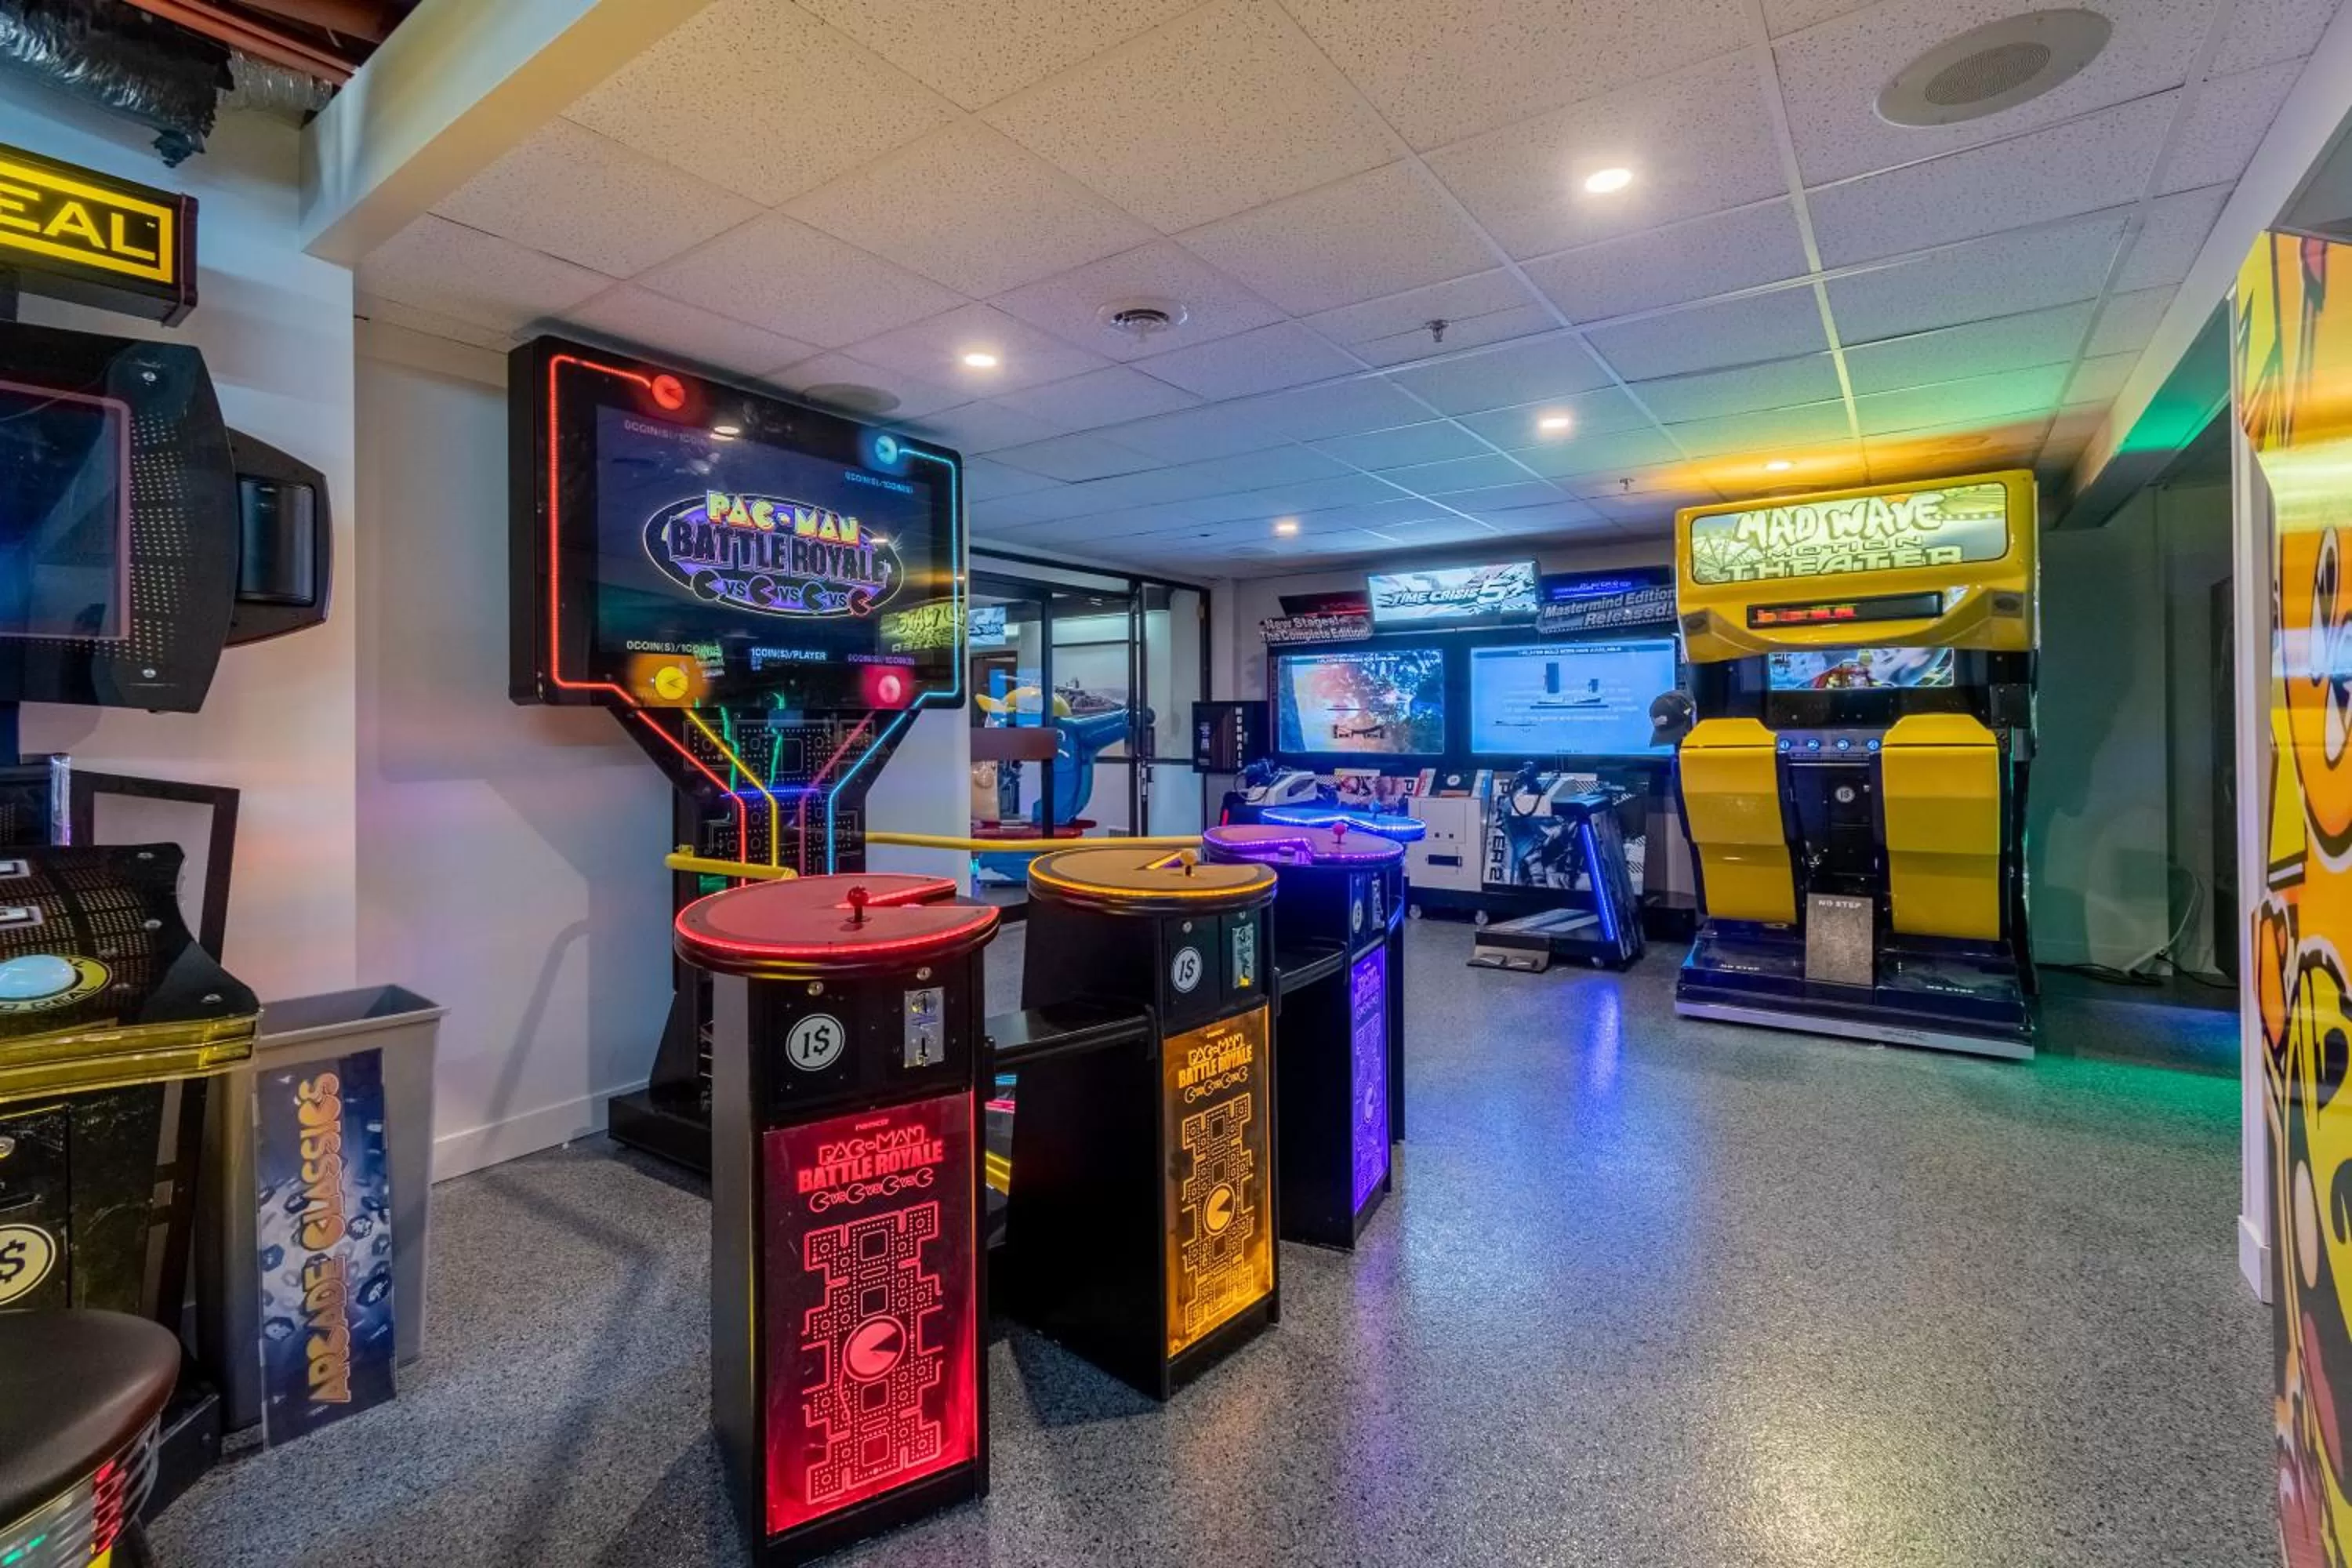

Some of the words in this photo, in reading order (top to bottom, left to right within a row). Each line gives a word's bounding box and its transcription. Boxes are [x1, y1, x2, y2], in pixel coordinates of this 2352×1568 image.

[706, 489, 861, 546] PAC-MAN
[1734, 505, 1819, 548] MAD
[1826, 492, 1947, 539] WAVE
[669, 515, 789, 577] BATTLE
[789, 533, 893, 588] ROYALE
[1769, 535, 1923, 558] MOTION
[1726, 546, 1963, 582] THEATER
[725, 579, 746, 597] VS
[777, 586, 800, 603] VS
[829, 593, 848, 608] VS
[1390, 587, 1428, 606] TIME
[1428, 589, 1479, 603] CRISIS
[1544, 595, 1624, 619] Mastermind
[1624, 587, 1677, 607] Edition
[1265, 617, 1292, 630] New
[1294, 615, 1340, 630] Stages!
[1584, 601, 1674, 626] Released!
[1260, 630, 1281, 641] The
[1283, 628, 1330, 641] Complete
[1330, 626, 1370, 641] Edition!
[1491, 782, 1510, 863] PLAYER
[1490, 866, 1502, 881] 2
[1178, 957, 1196, 982] 1$
[802, 1023, 831, 1060] 1$
[1178, 1058, 1218, 1089] BATTLE
[297, 1072, 347, 1250] CLASSICS
[818, 1124, 931, 1167] PAC-MAN
[797, 1154, 875, 1194] BATTLE
[874, 1139, 944, 1178] ROYALE
[303, 1255, 352, 1403] ARCADE
